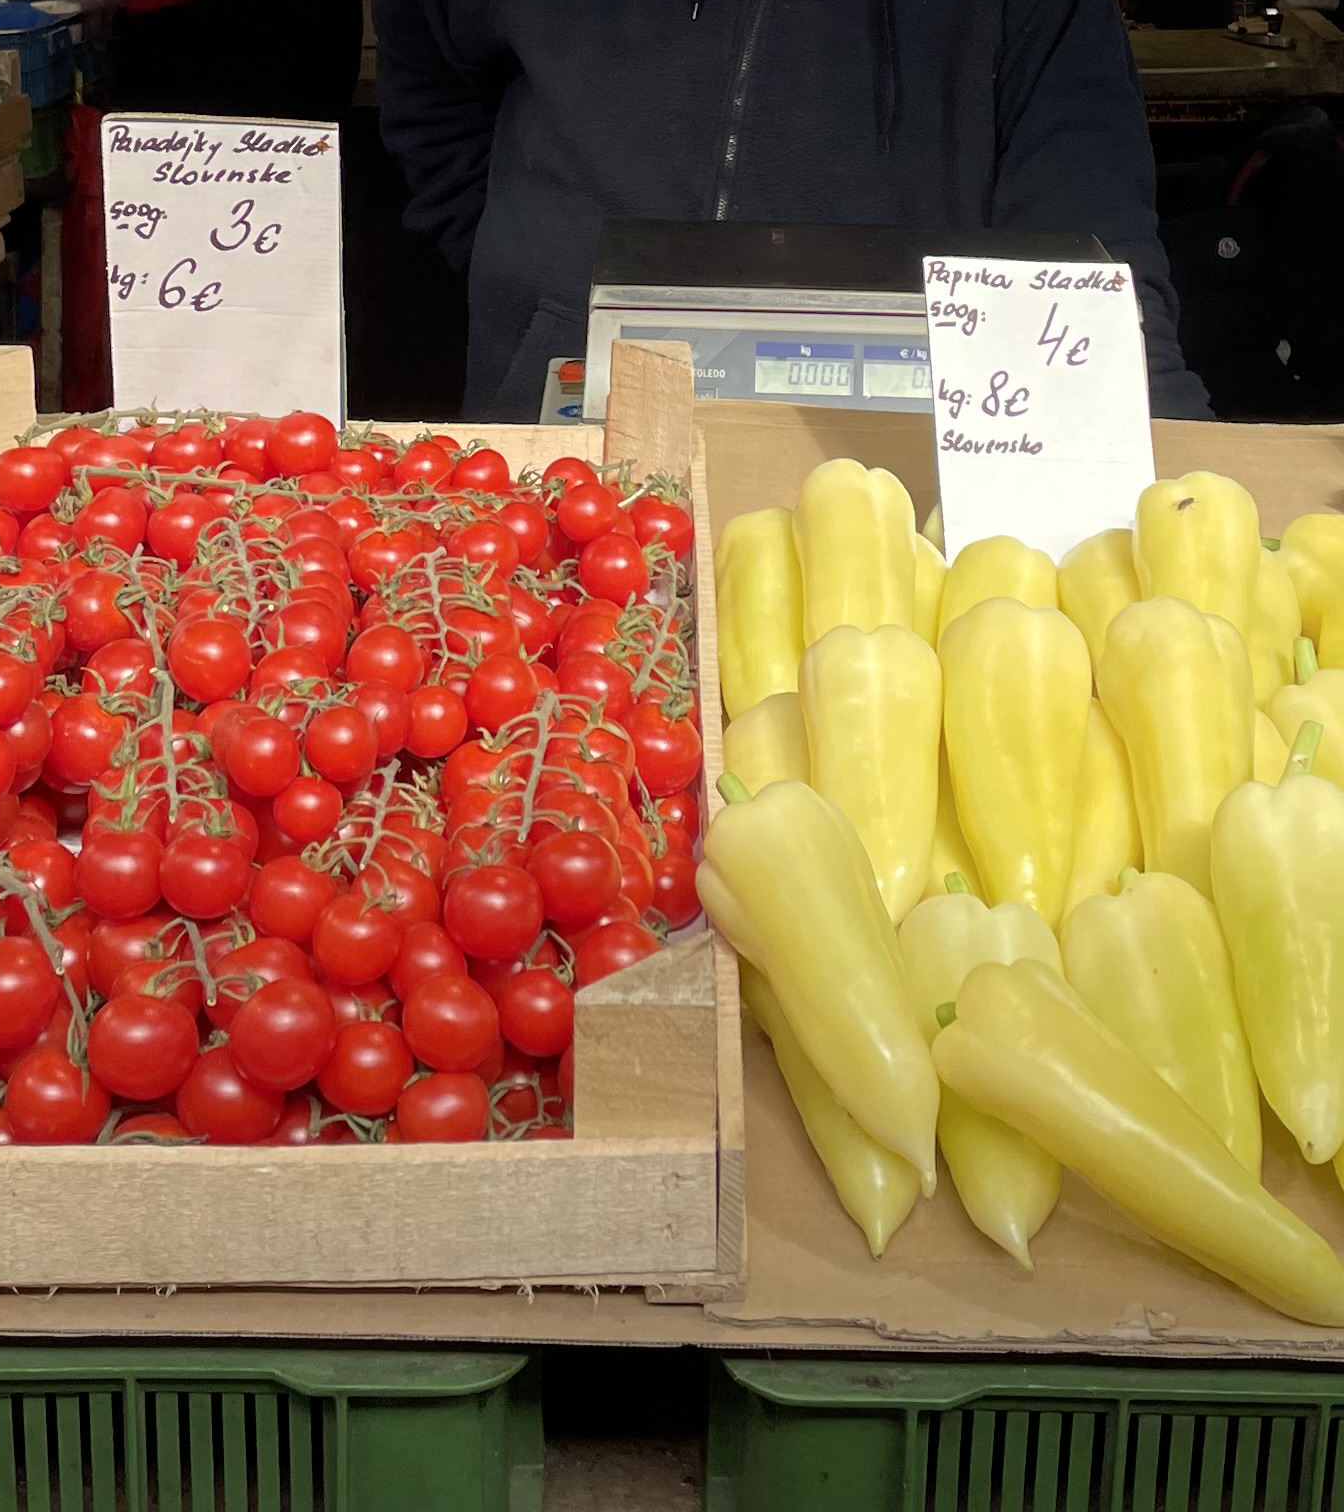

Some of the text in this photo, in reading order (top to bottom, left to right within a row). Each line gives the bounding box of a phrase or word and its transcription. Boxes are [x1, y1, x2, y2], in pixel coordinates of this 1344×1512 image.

[108, 124, 222, 166] Paradajky
[925, 260, 1014, 297] Paprika
[800, 344, 812, 357] kg
[940, 428, 1044, 456] Slovensko
